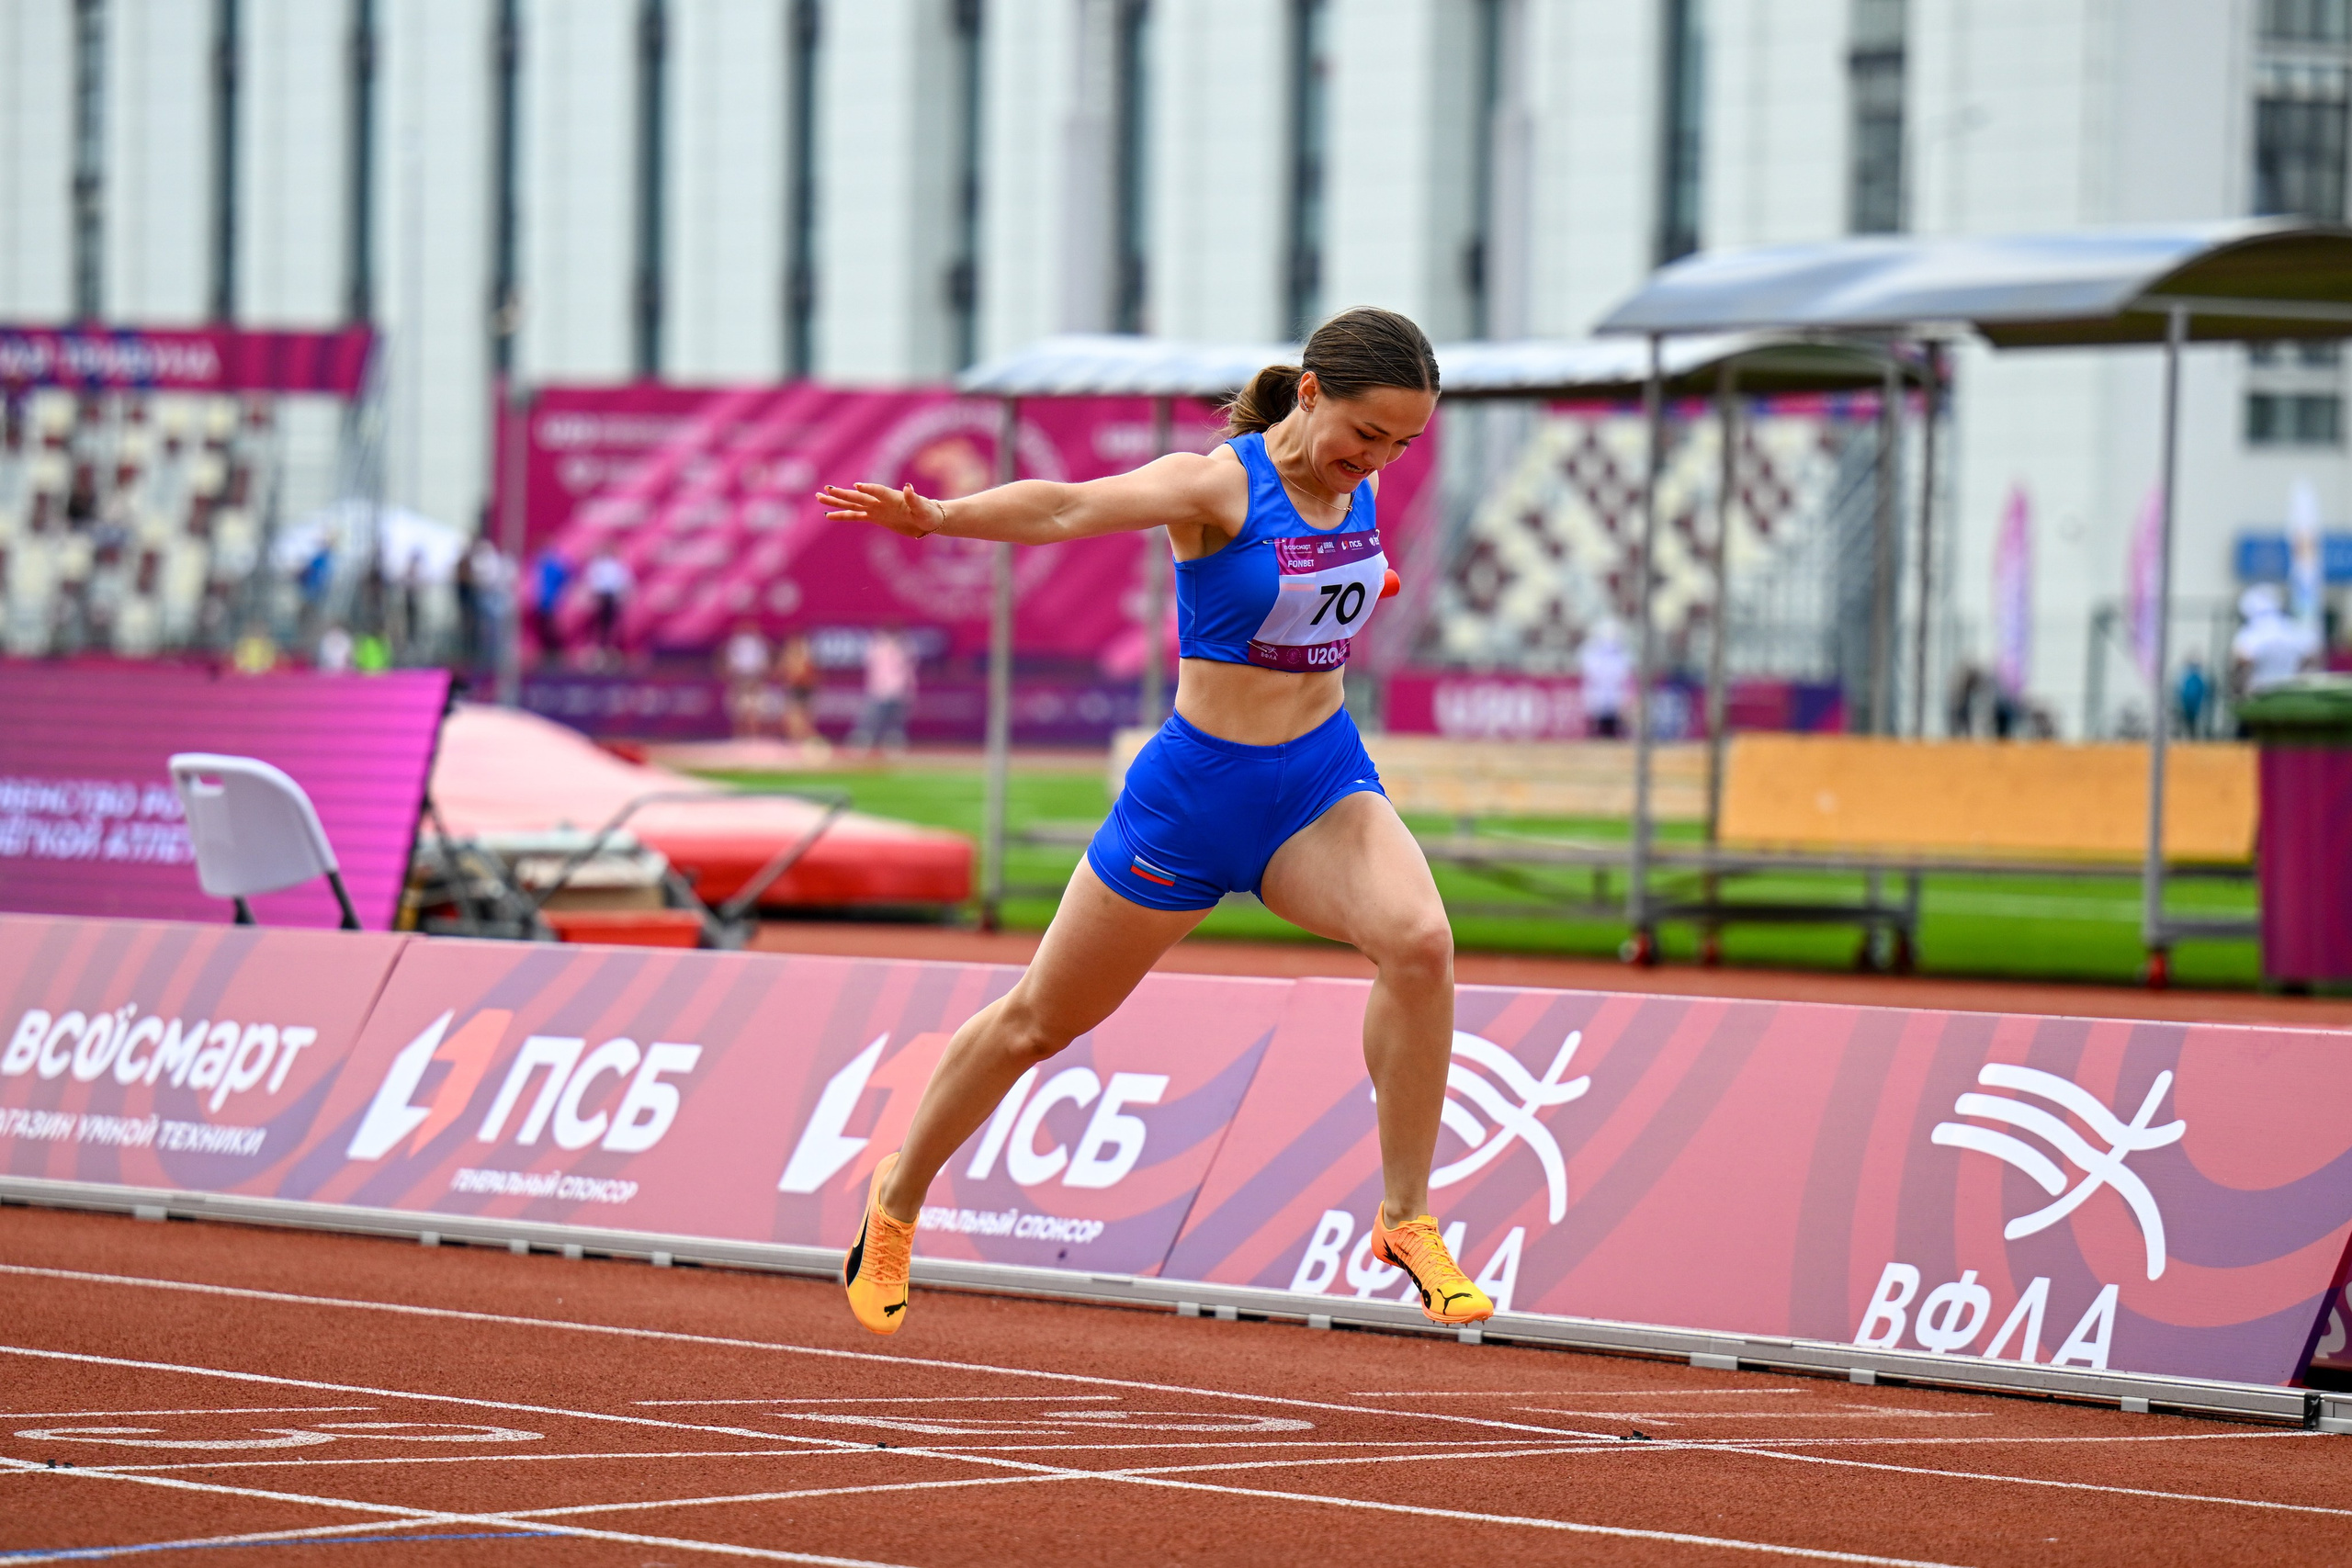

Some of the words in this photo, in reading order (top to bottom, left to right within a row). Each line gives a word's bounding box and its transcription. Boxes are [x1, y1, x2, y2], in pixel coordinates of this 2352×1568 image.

[1349, 540, 1363, 548] ПСБ
[1288, 559, 1315, 568] FONBET
[1309, 581, 1365, 626] 70
[1307, 648, 1338, 664] U20
[477, 1034, 703, 1154] ПСБ
[77, 1112, 160, 1148] УМНОЙ
[157, 1119, 267, 1157] ТЕХНИКИ
[556, 1174, 639, 1204] СПОНСОР
[918, 1205, 1018, 1237] НЕРАЛЬНЫЙ
[1013, 1213, 1104, 1243] СПОНСОР
[1854, 1261, 2120, 1370] ВФЛА
